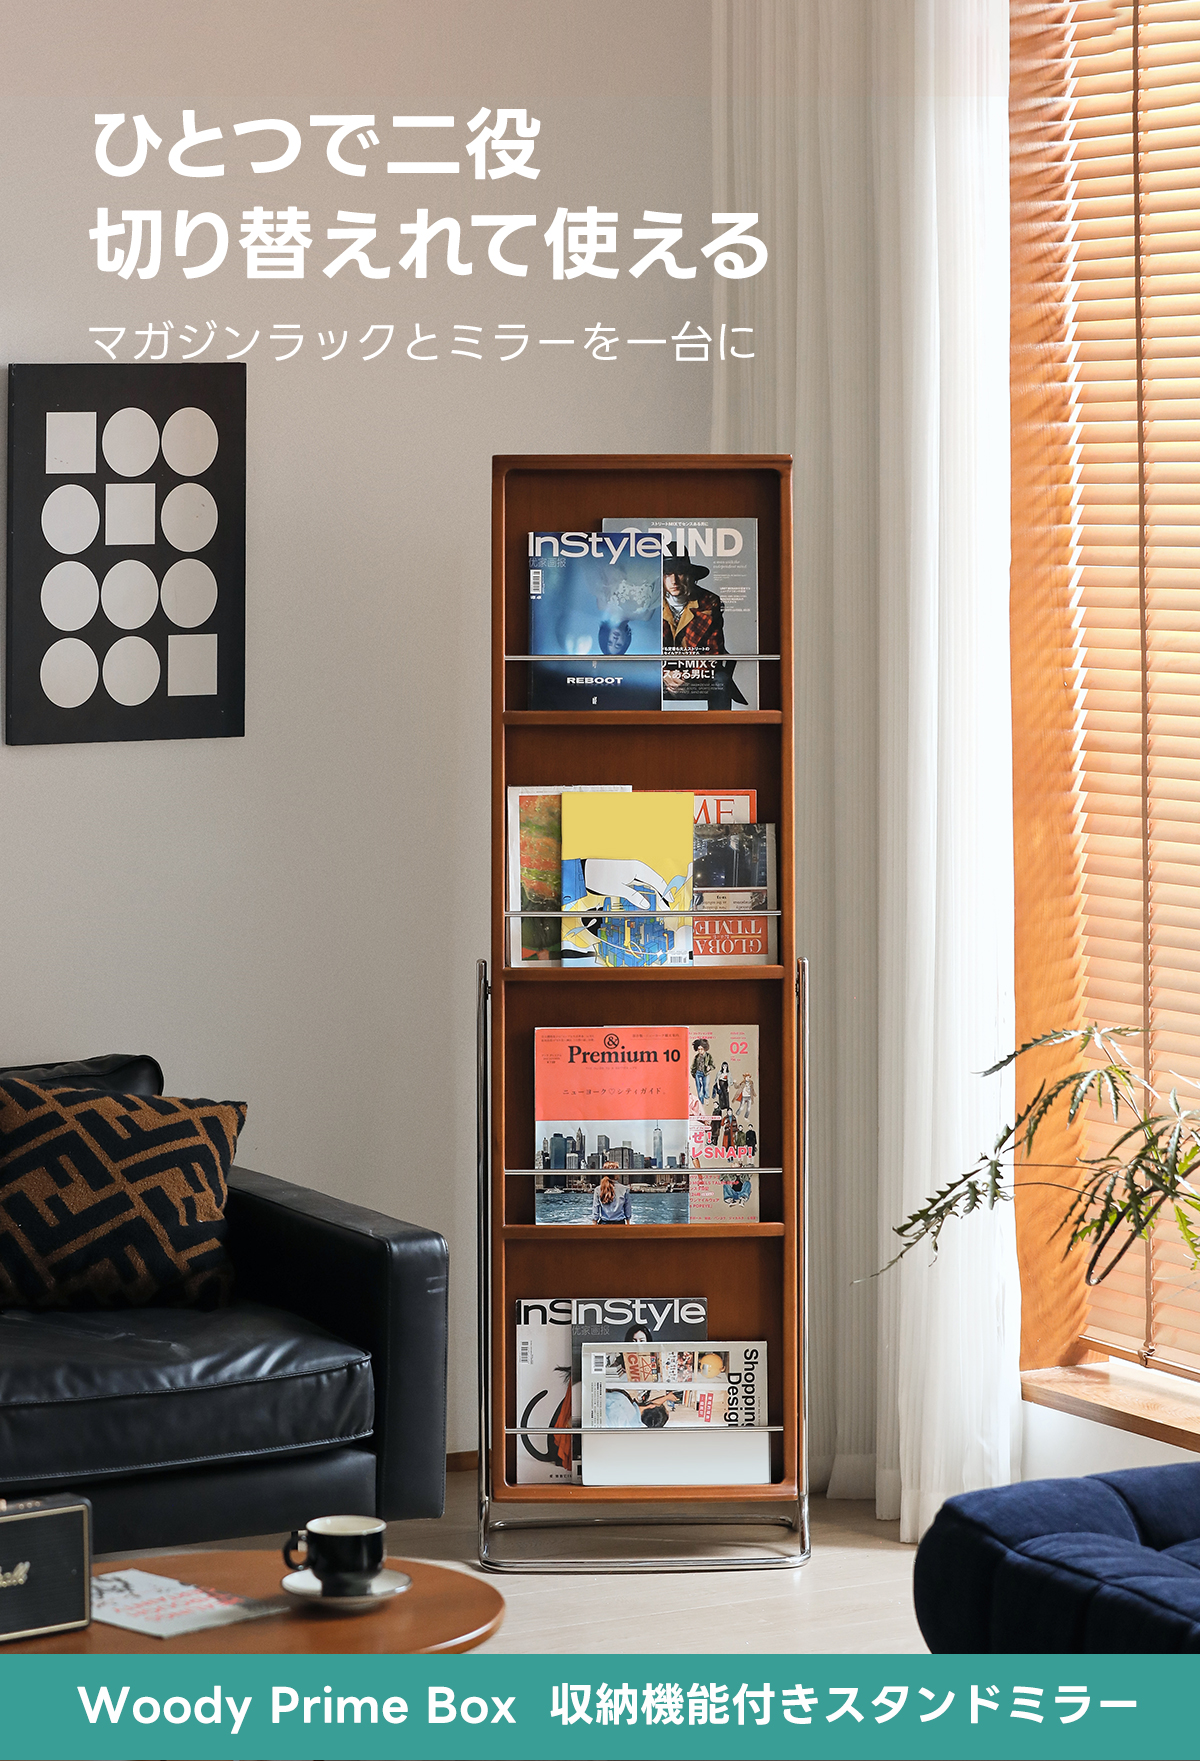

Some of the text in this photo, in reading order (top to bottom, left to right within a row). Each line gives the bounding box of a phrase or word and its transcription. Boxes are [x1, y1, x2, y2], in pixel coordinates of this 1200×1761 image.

[528, 531, 662, 564] InStyle
[619, 527, 743, 557] RIND
[528, 557, 567, 568] 优家画报
[566, 676, 624, 685] REBOOT
[694, 938, 762, 954] GLOBA
[568, 1045, 659, 1063] Premium
[663, 1049, 681, 1062] 10
[730, 1041, 748, 1055] 02
[571, 1299, 707, 1331] InStyle
[572, 1325, 610, 1336] 优家画报
